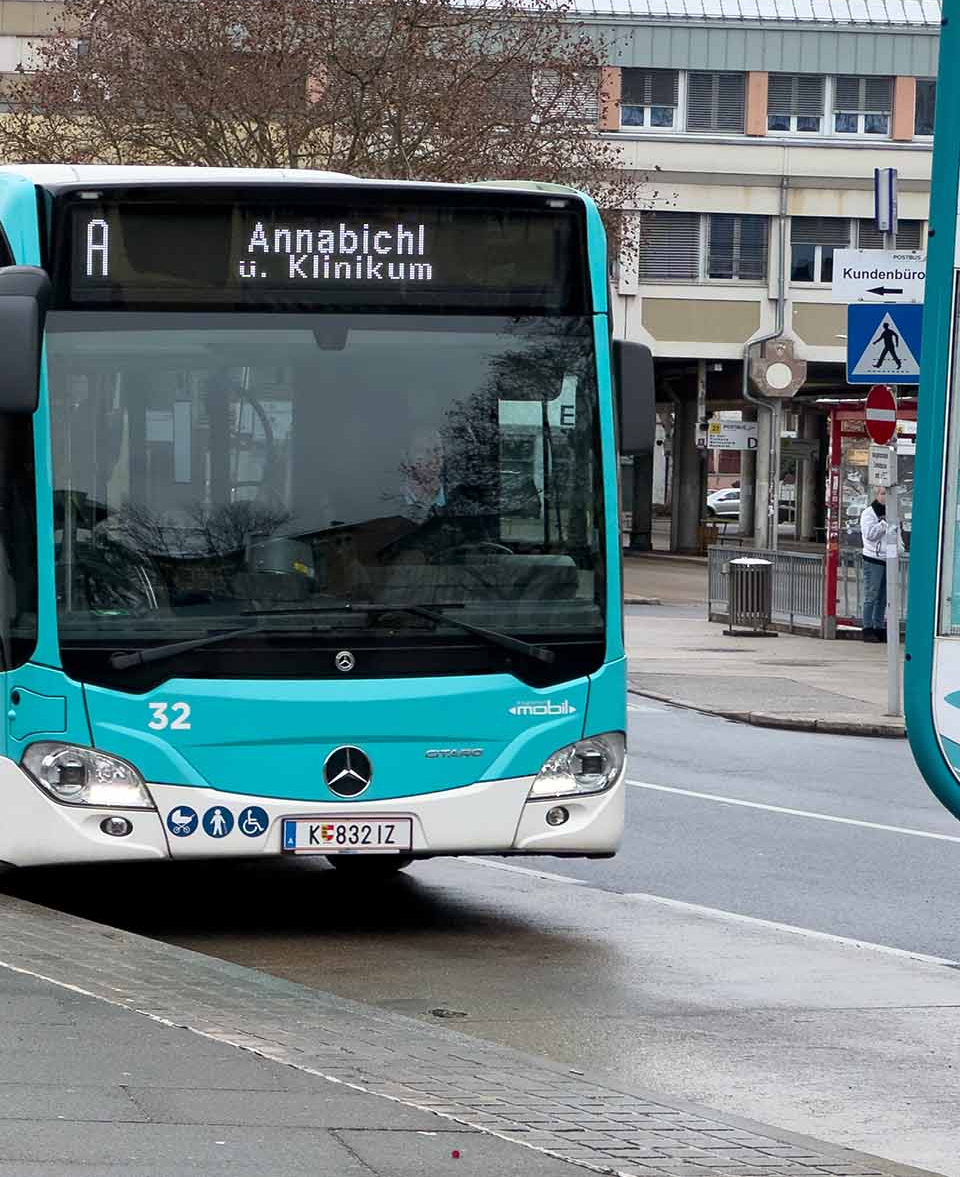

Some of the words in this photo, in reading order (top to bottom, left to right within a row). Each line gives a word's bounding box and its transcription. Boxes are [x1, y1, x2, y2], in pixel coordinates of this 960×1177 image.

[86, 218, 109, 276] A
[248, 222, 425, 255] Annabichl
[239, 260, 268, 279] ü.
[289, 254, 433, 280] Klinikum
[843, 267, 926, 280] Kundenbüro
[747, 437, 758, 449] D
[148, 702, 191, 730] 32
[517, 699, 568, 715] mobil
[309, 825, 320, 845] K
[336, 825, 372, 845] 832
